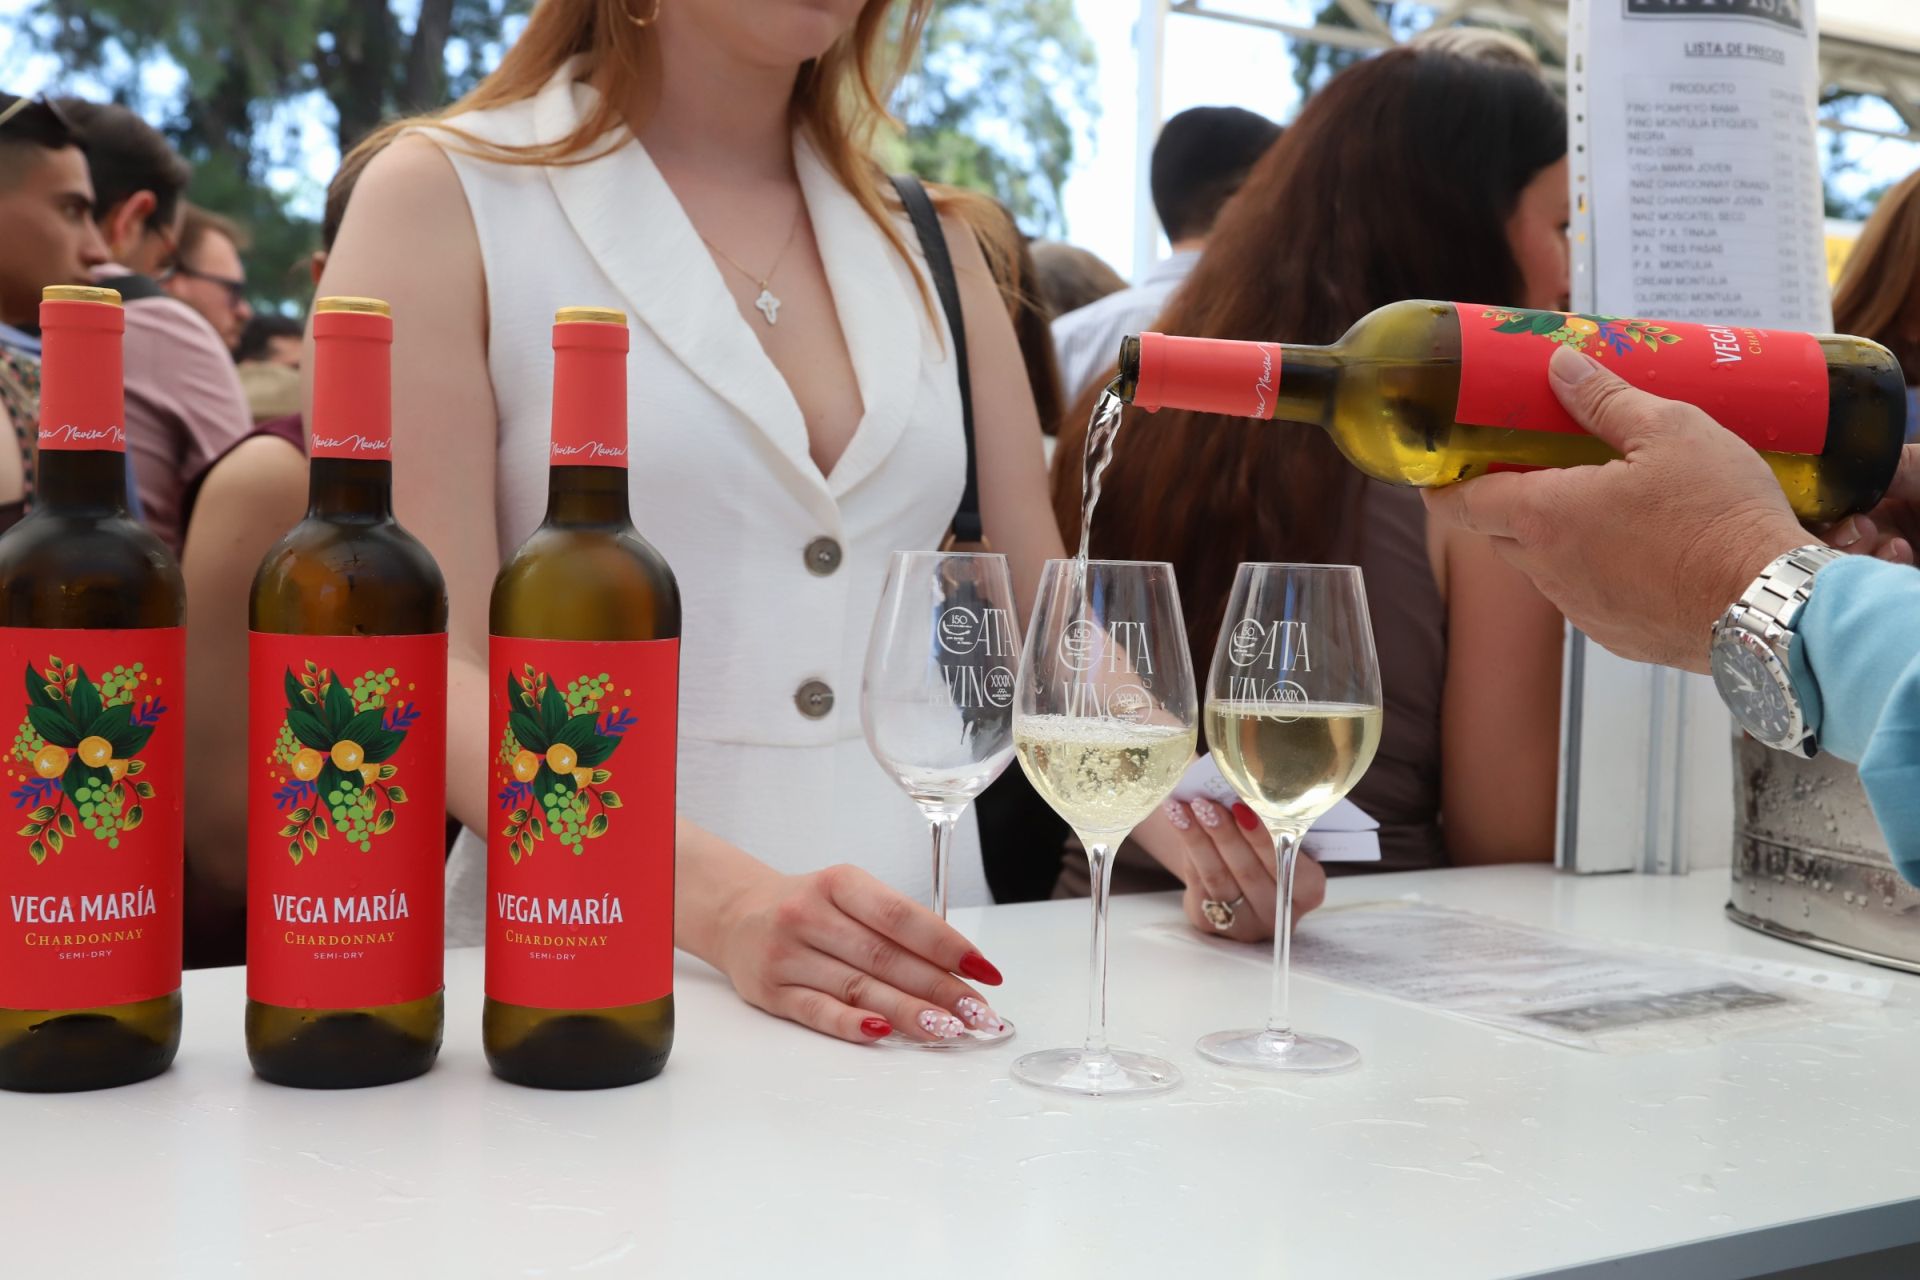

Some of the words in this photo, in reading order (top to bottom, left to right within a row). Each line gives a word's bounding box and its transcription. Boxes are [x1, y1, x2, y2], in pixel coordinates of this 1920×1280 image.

[1684, 41, 1723, 55] LISTA
[1726, 42, 1743, 55] DE
[1669, 82, 1736, 95] PRODUCTO
[1272, 688, 1300, 703] XXXIX
[10, 895, 75, 924] VEGA
[80, 884, 156, 922] MARÍA
[273, 893, 328, 924] VEGA
[333, 888, 409, 924] MARÍA
[497, 891, 543, 924] VEGA
[547, 892, 623, 925] MARÍA
[59, 949, 112, 961] SEMI-DRY
[313, 951, 365, 960] SEMI-DRY
[529, 951, 576, 961] SEMI-DRY
